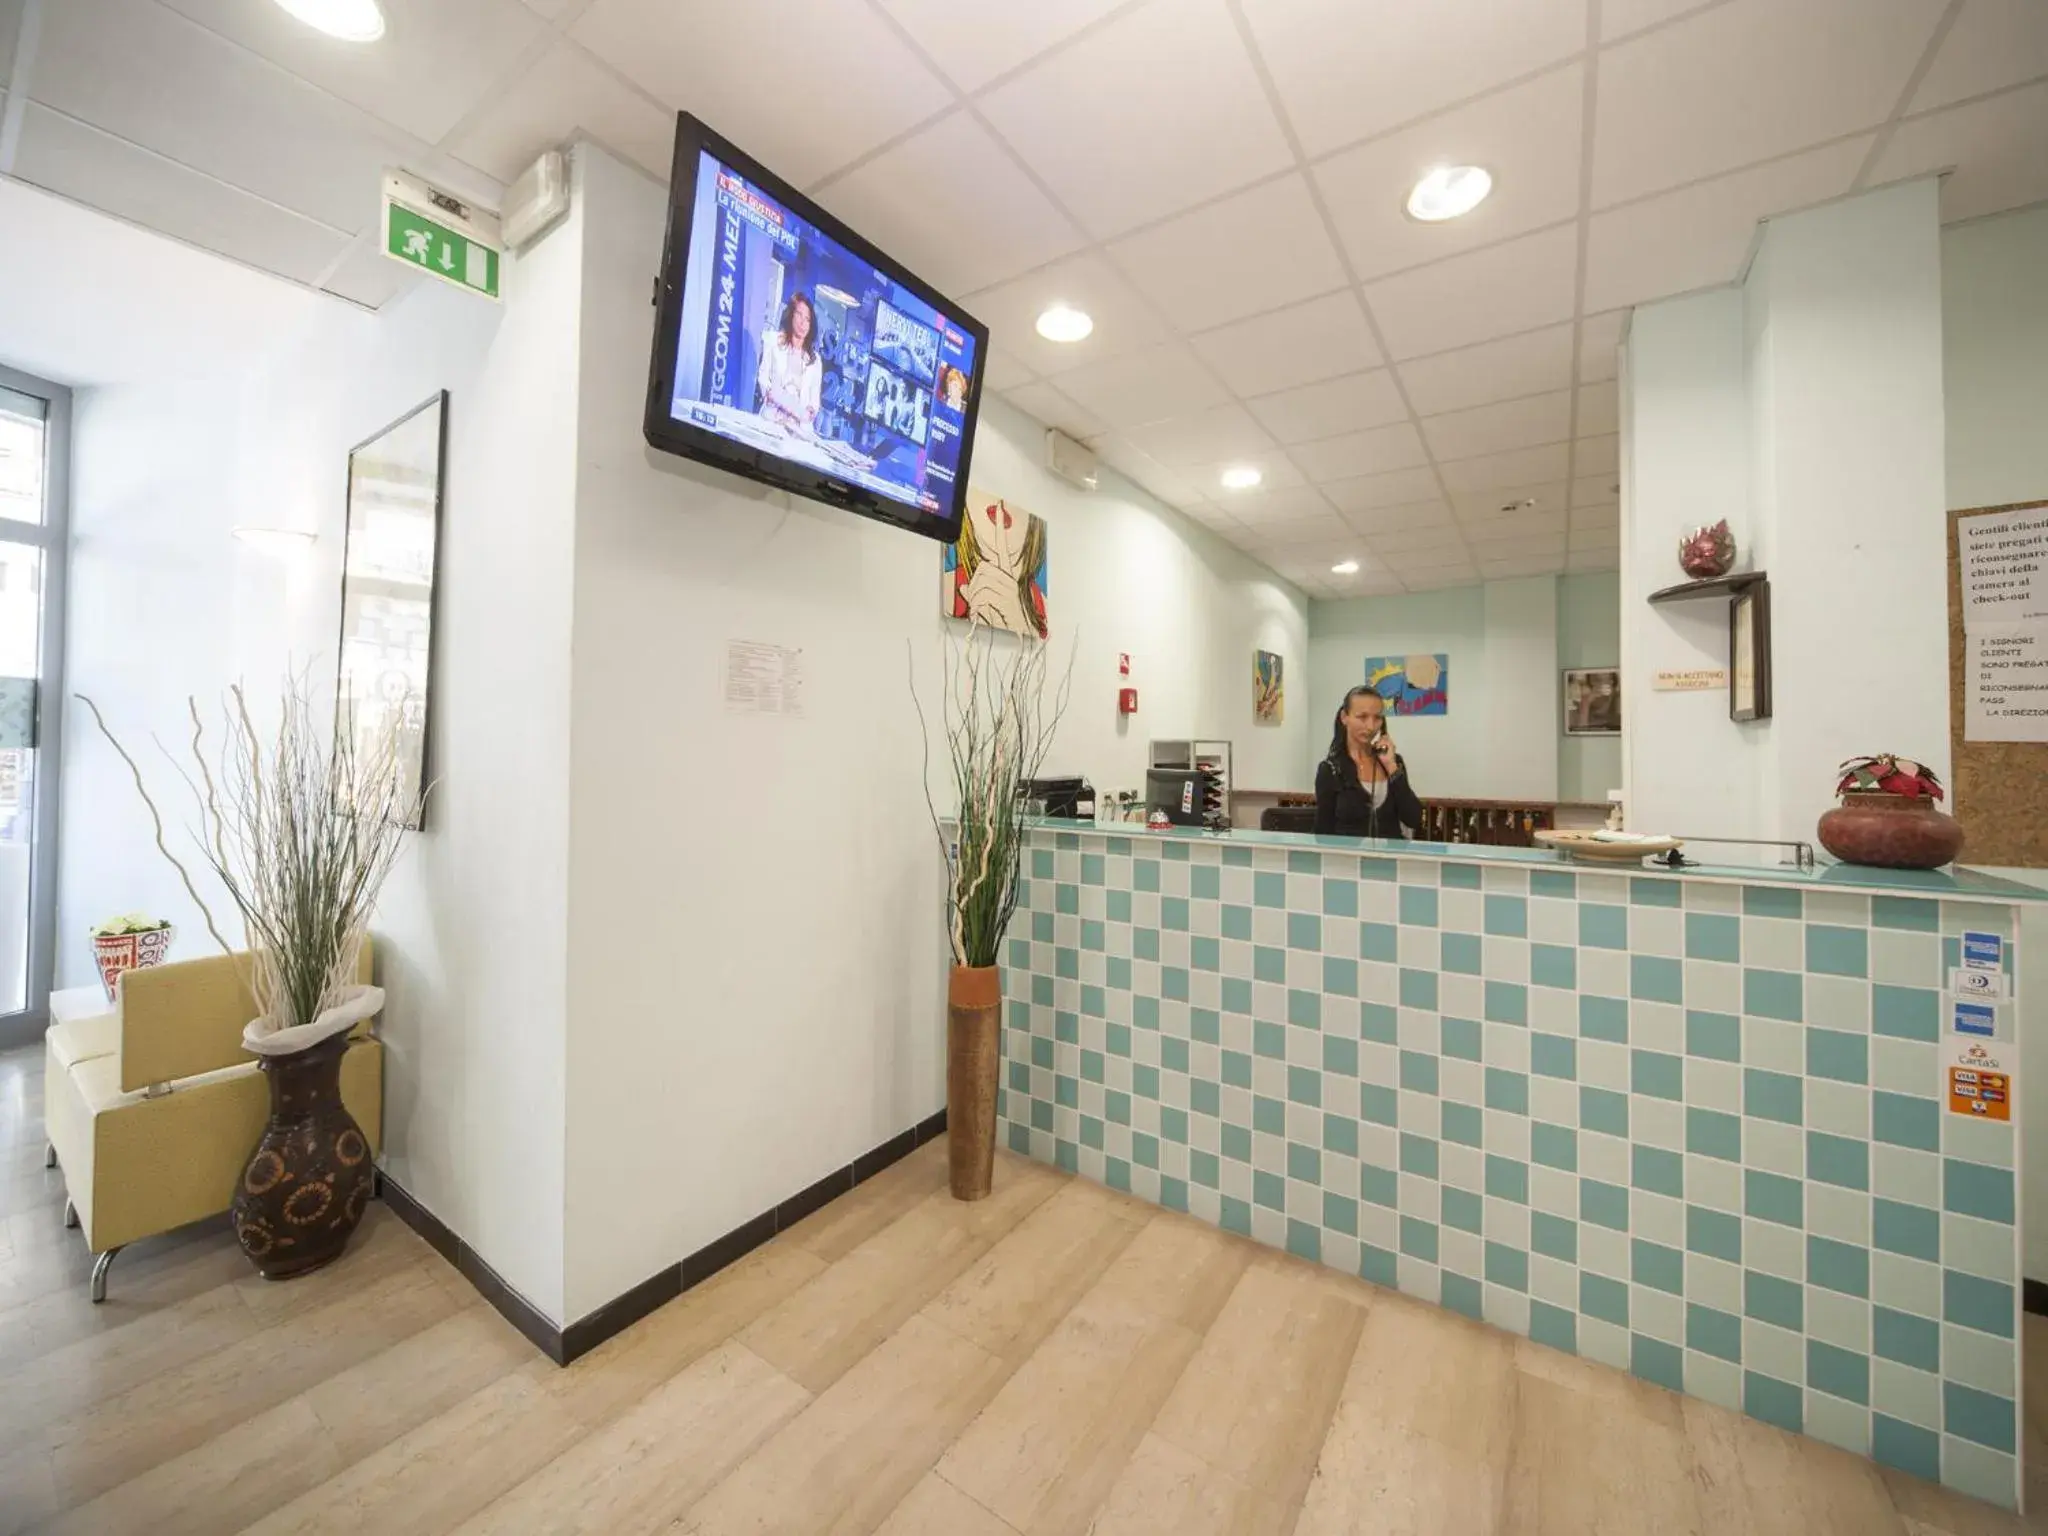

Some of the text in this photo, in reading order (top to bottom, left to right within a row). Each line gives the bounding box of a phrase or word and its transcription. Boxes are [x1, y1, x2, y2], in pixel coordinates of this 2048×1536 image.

[1968, 523, 2009, 537] Gentili
[1998, 535, 2042, 550] pregati
[1971, 563, 2038, 577] chiavi della
[1972, 576, 2031, 591] camera al
[1972, 592, 2031, 604] check-out
[1990, 637, 2035, 645] SIGNORI
[1980, 649, 2022, 657] CLIENTI
[1980, 672, 1992, 680] DI
[1985, 709, 2000, 717] LA
